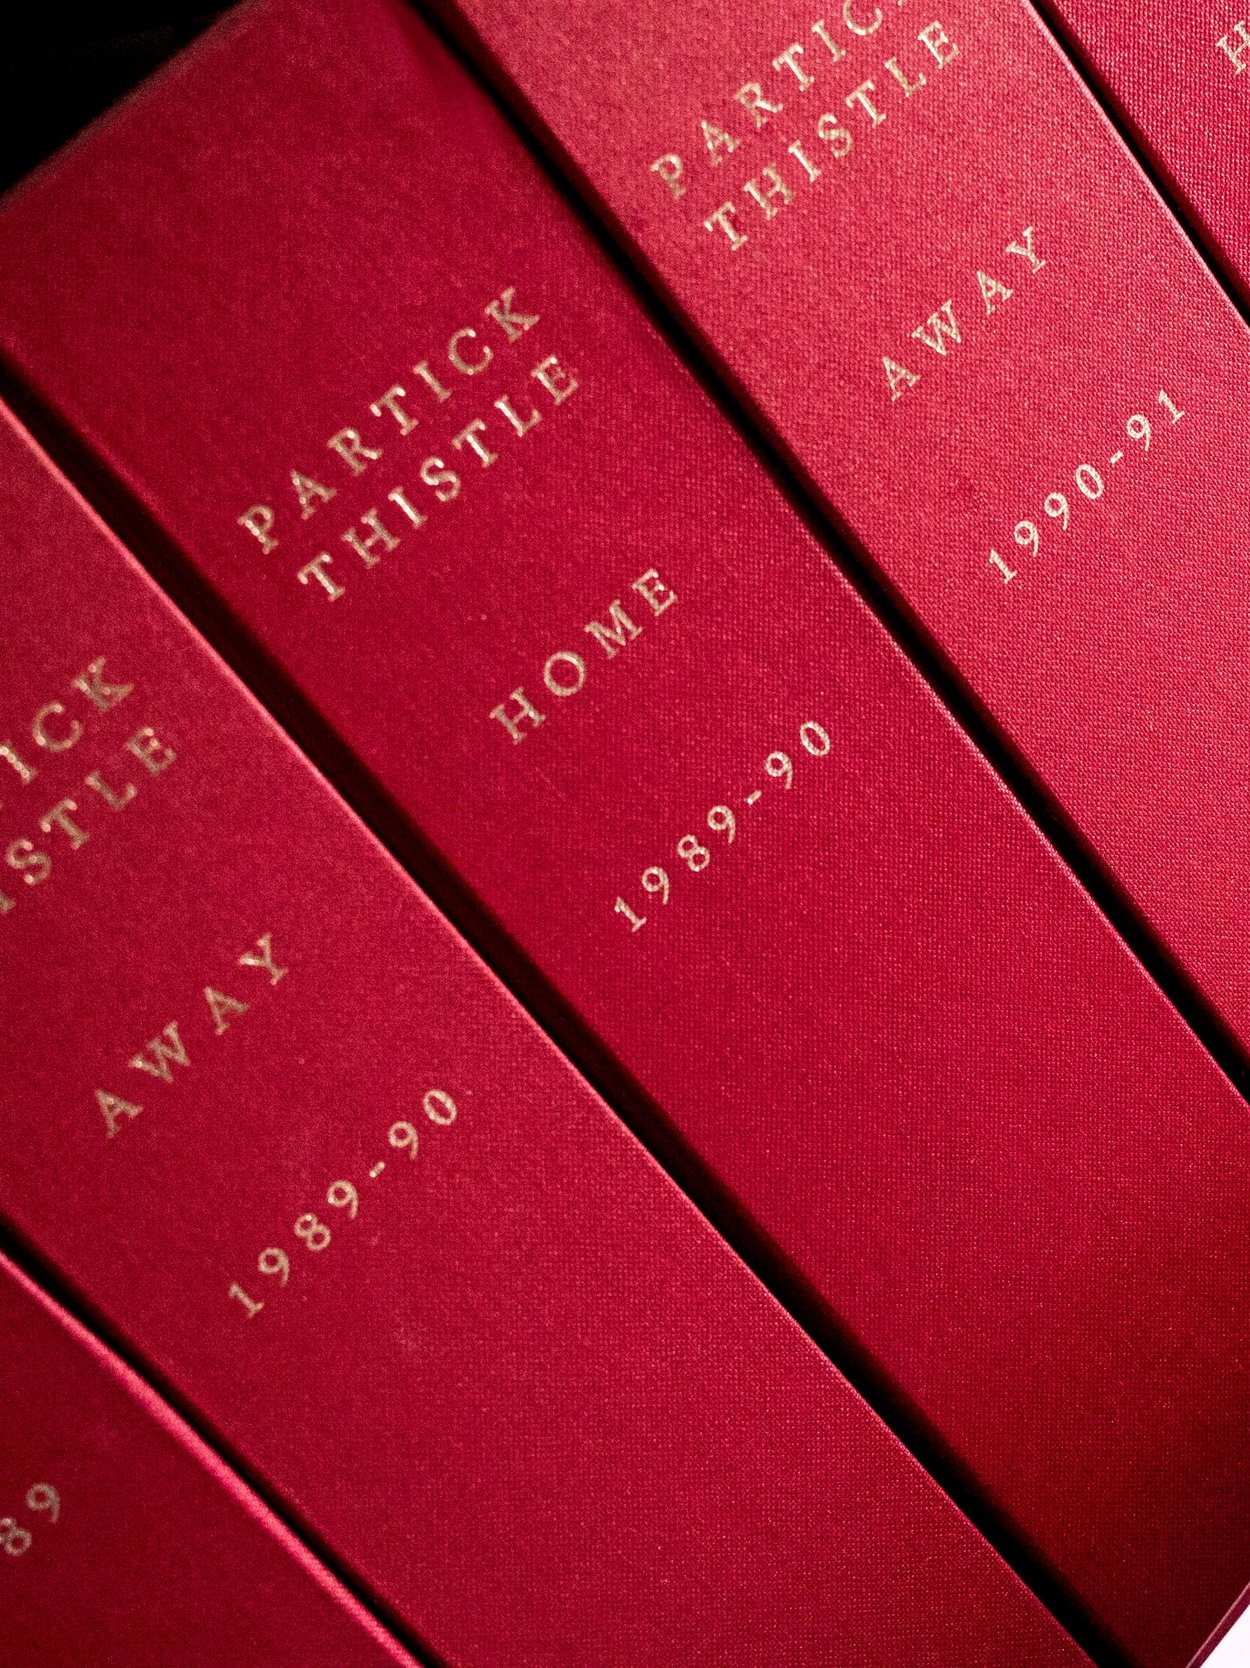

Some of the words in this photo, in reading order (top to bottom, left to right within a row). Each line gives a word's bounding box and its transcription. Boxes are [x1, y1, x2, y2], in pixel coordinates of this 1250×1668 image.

[650, 0, 904, 199] PARTIC
[704, 20, 961, 252] THISTLE
[882, 226, 1047, 401] AWAY
[238, 286, 540, 554] PARTICK
[298, 355, 579, 602] THISTLE
[988, 388, 1186, 586] 1990-91
[490, 568, 678, 743] HOME
[0, 726, 176, 915] STLE
[614, 720, 832, 932] 1989-90
[94, 934, 290, 1138] AWAY
[228, 1088, 458, 1317] 1989-90
[0, 1482, 61, 1557] 89
